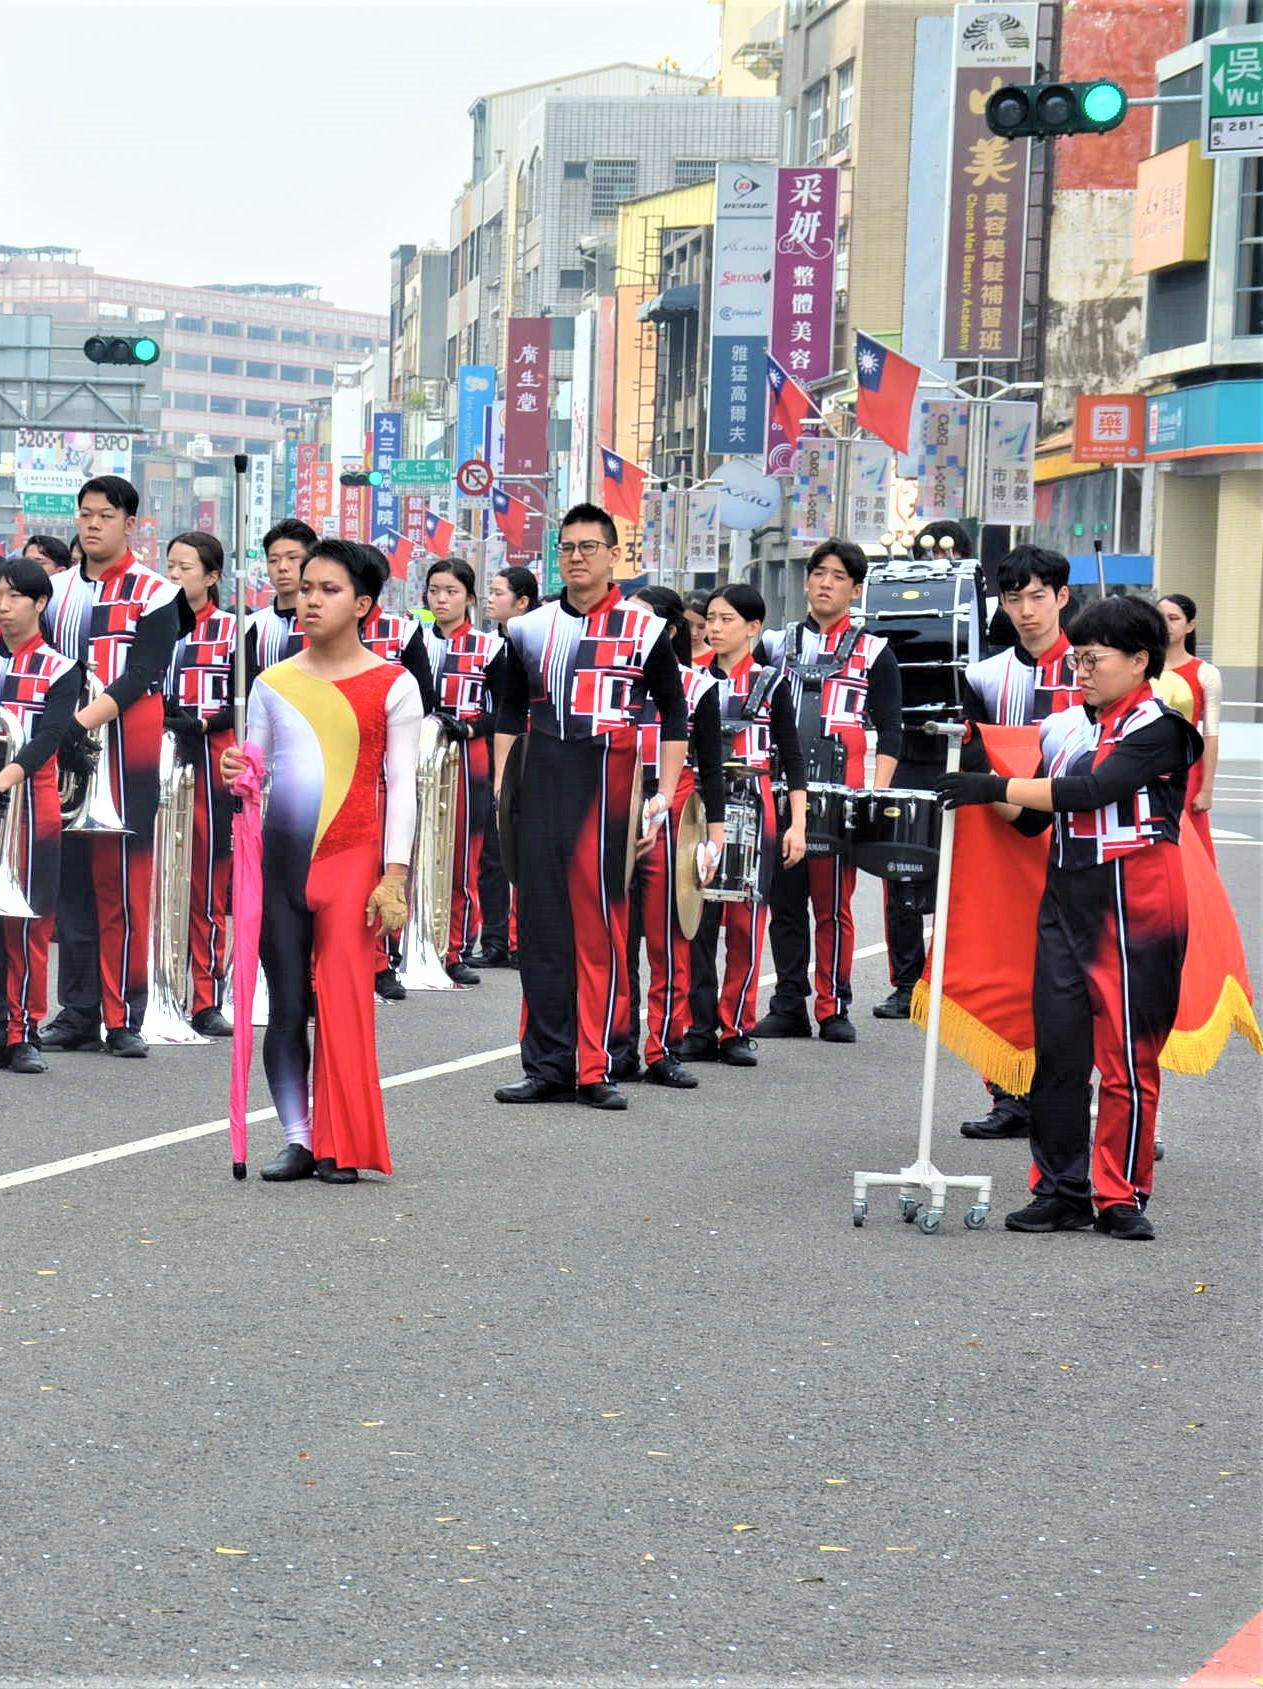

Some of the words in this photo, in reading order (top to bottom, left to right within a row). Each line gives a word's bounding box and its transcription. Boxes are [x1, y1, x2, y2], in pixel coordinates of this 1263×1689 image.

[1227, 89, 1263, 106] Wu
[720, 271, 765, 285] SRIXON
[978, 192, 1008, 350] 美容美髮補習班
[789, 266, 814, 370] 整體美容
[513, 343, 541, 412] 廣生堂
[729, 345, 748, 442] 雅猛高爾夫
[938, 414, 949, 445] EXPO
[1099, 411, 1122, 436] 藥
[95, 434, 129, 451] EXPO
[810, 451, 819, 476] EXPO
[896, 864, 924, 873] YAMAHA
